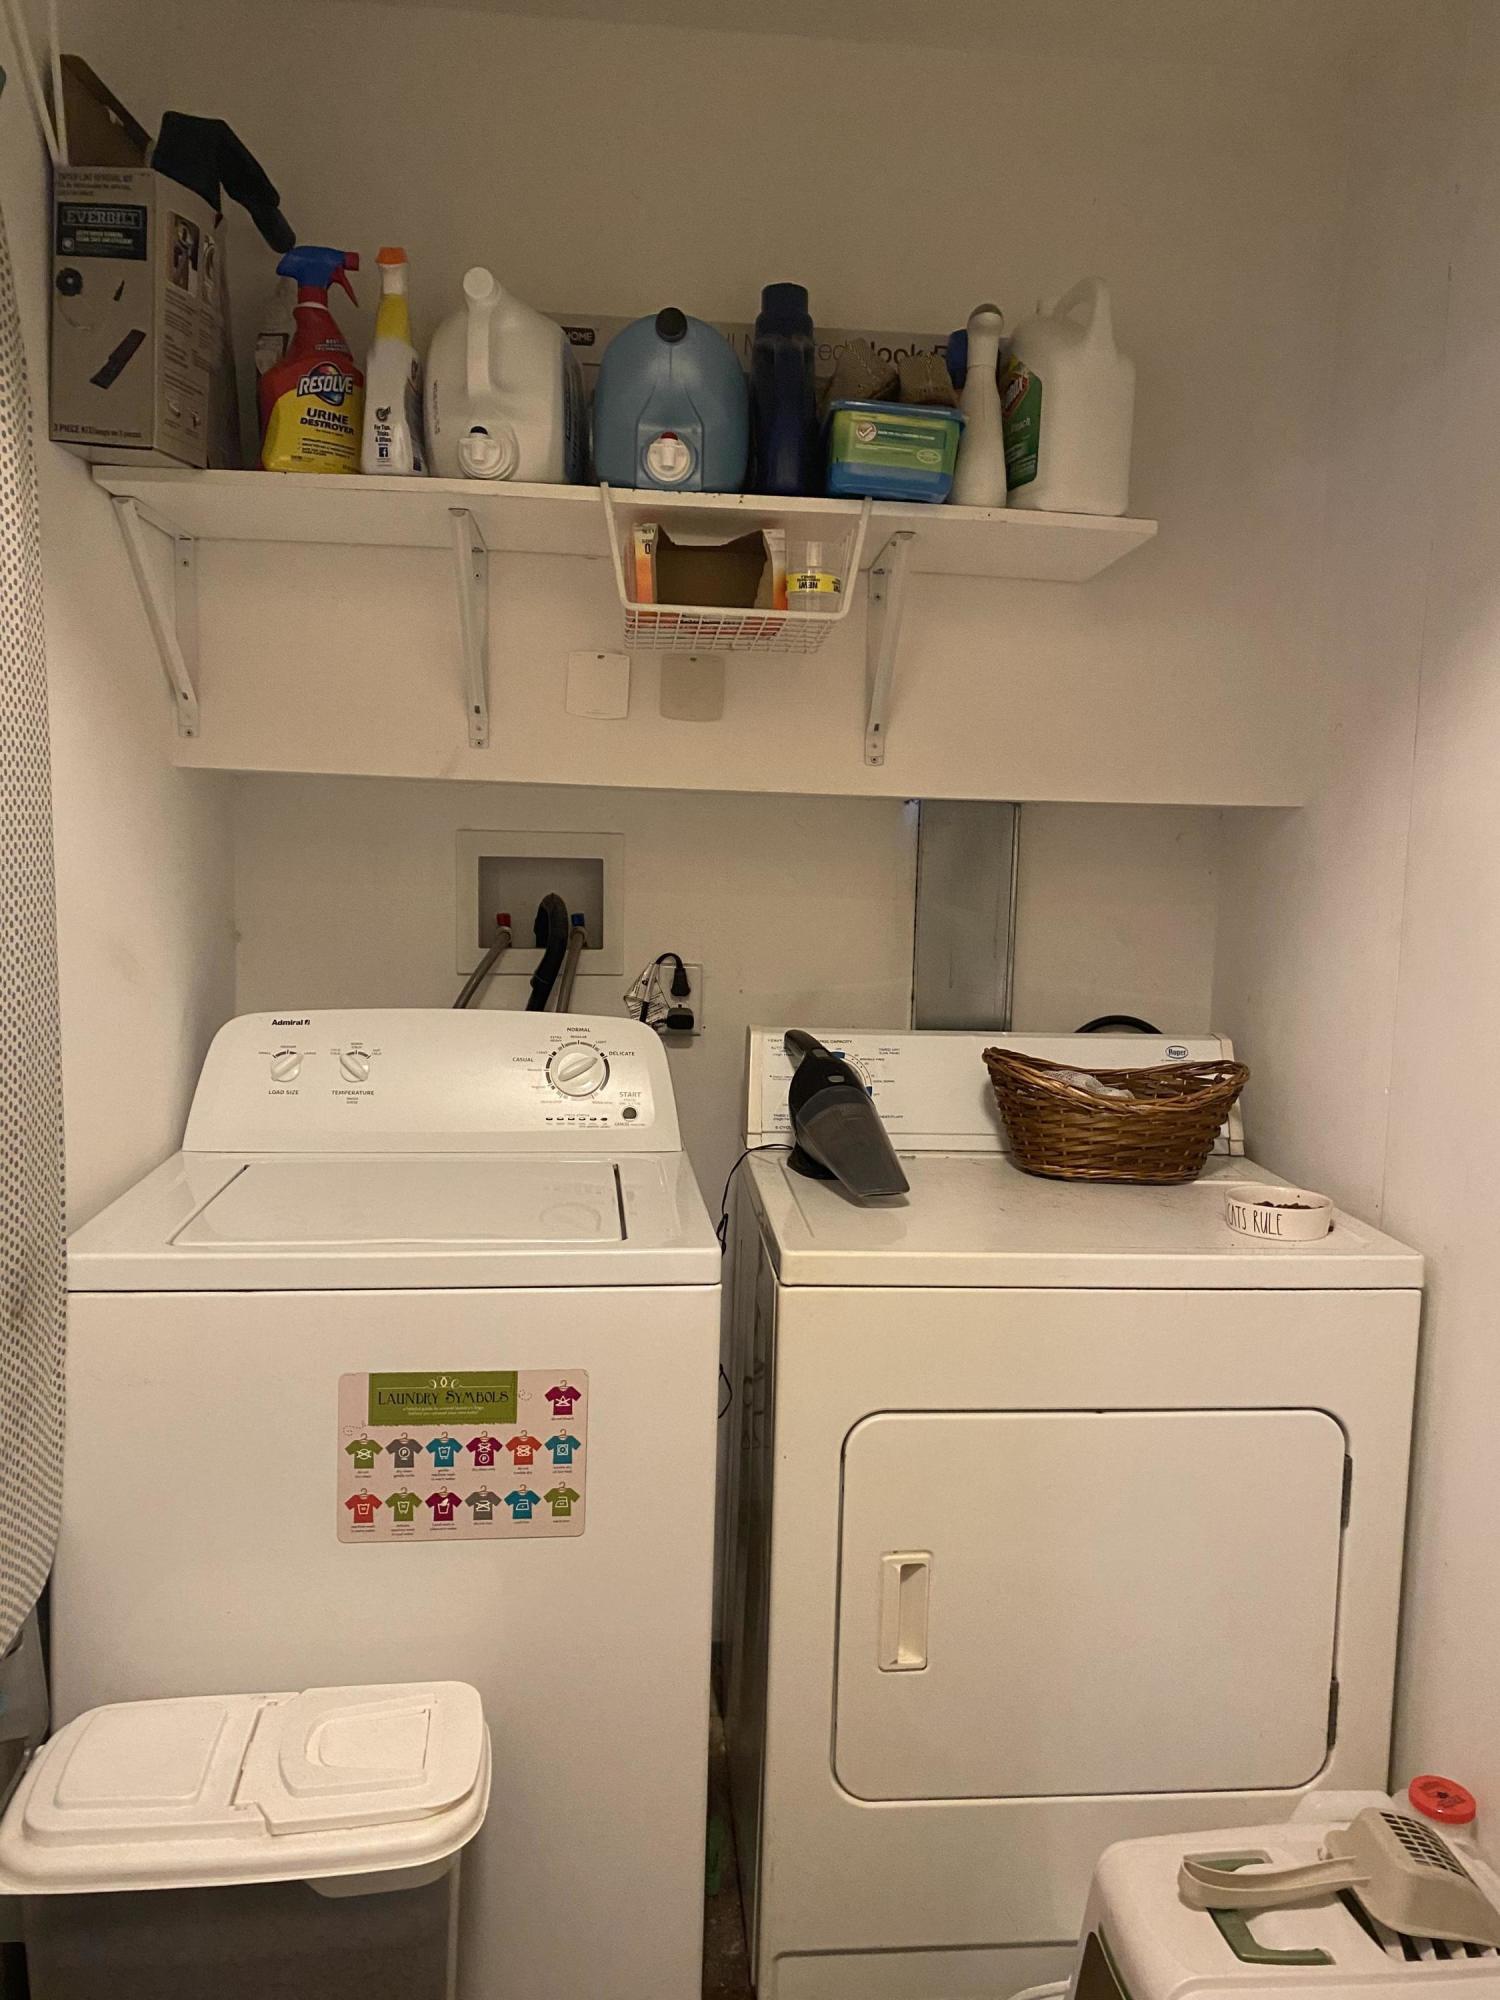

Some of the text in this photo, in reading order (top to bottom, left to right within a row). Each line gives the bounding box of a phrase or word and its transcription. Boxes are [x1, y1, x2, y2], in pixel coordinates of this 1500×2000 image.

[66, 210, 138, 226] EVERBILT
[298, 375, 353, 396] RESOLVE
[306, 407, 349, 426] URINE
[299, 418, 355, 435] DESTROYER
[798, 581, 818, 589] NEW!
[1226, 1202, 1283, 1236] CATS RULE
[378, 1390, 509, 1405] LAUNDRY SYMBOLS
